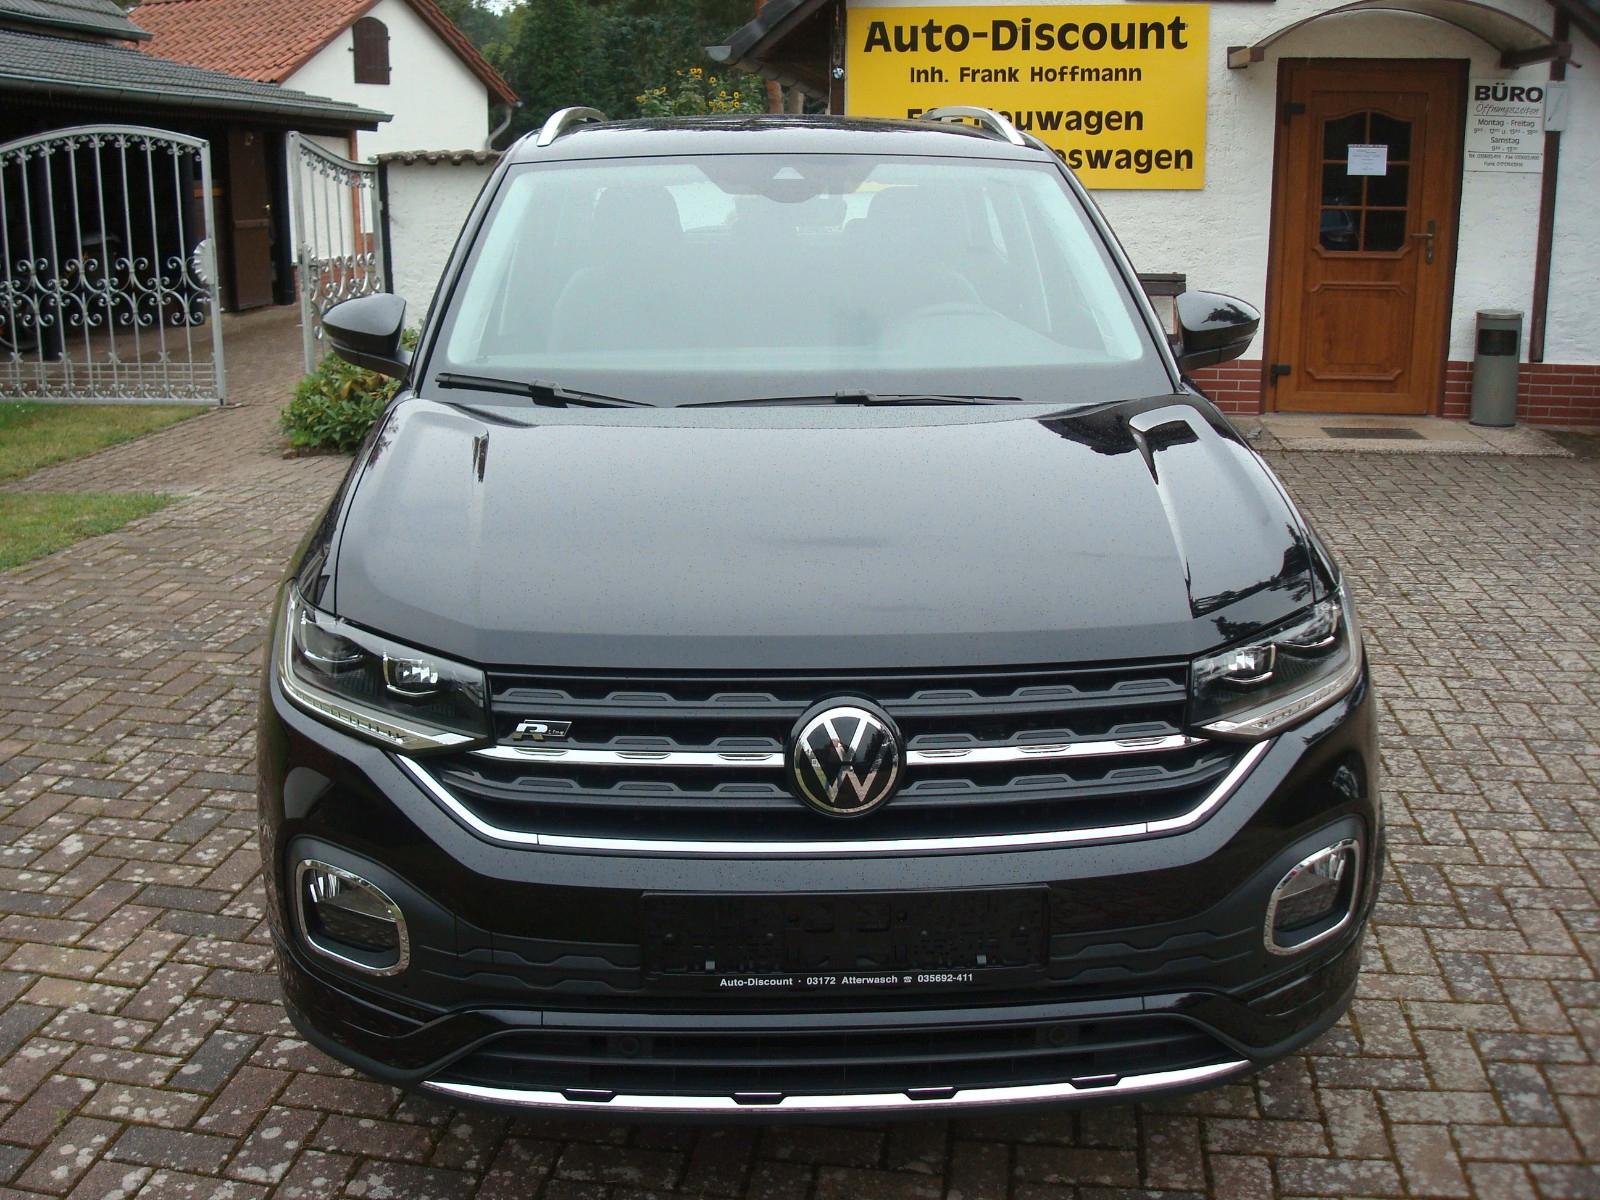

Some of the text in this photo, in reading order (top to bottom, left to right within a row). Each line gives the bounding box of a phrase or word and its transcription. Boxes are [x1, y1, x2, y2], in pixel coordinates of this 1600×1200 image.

[864, 16, 1188, 52] Auto-Discount
[910, 65, 1142, 83] Inh. Frank Hoffmann
[1474, 82, 1544, 103] BÜRO
[720, 974, 973, 987] Auto-Discount 03172 Atterwasch 035692-411
